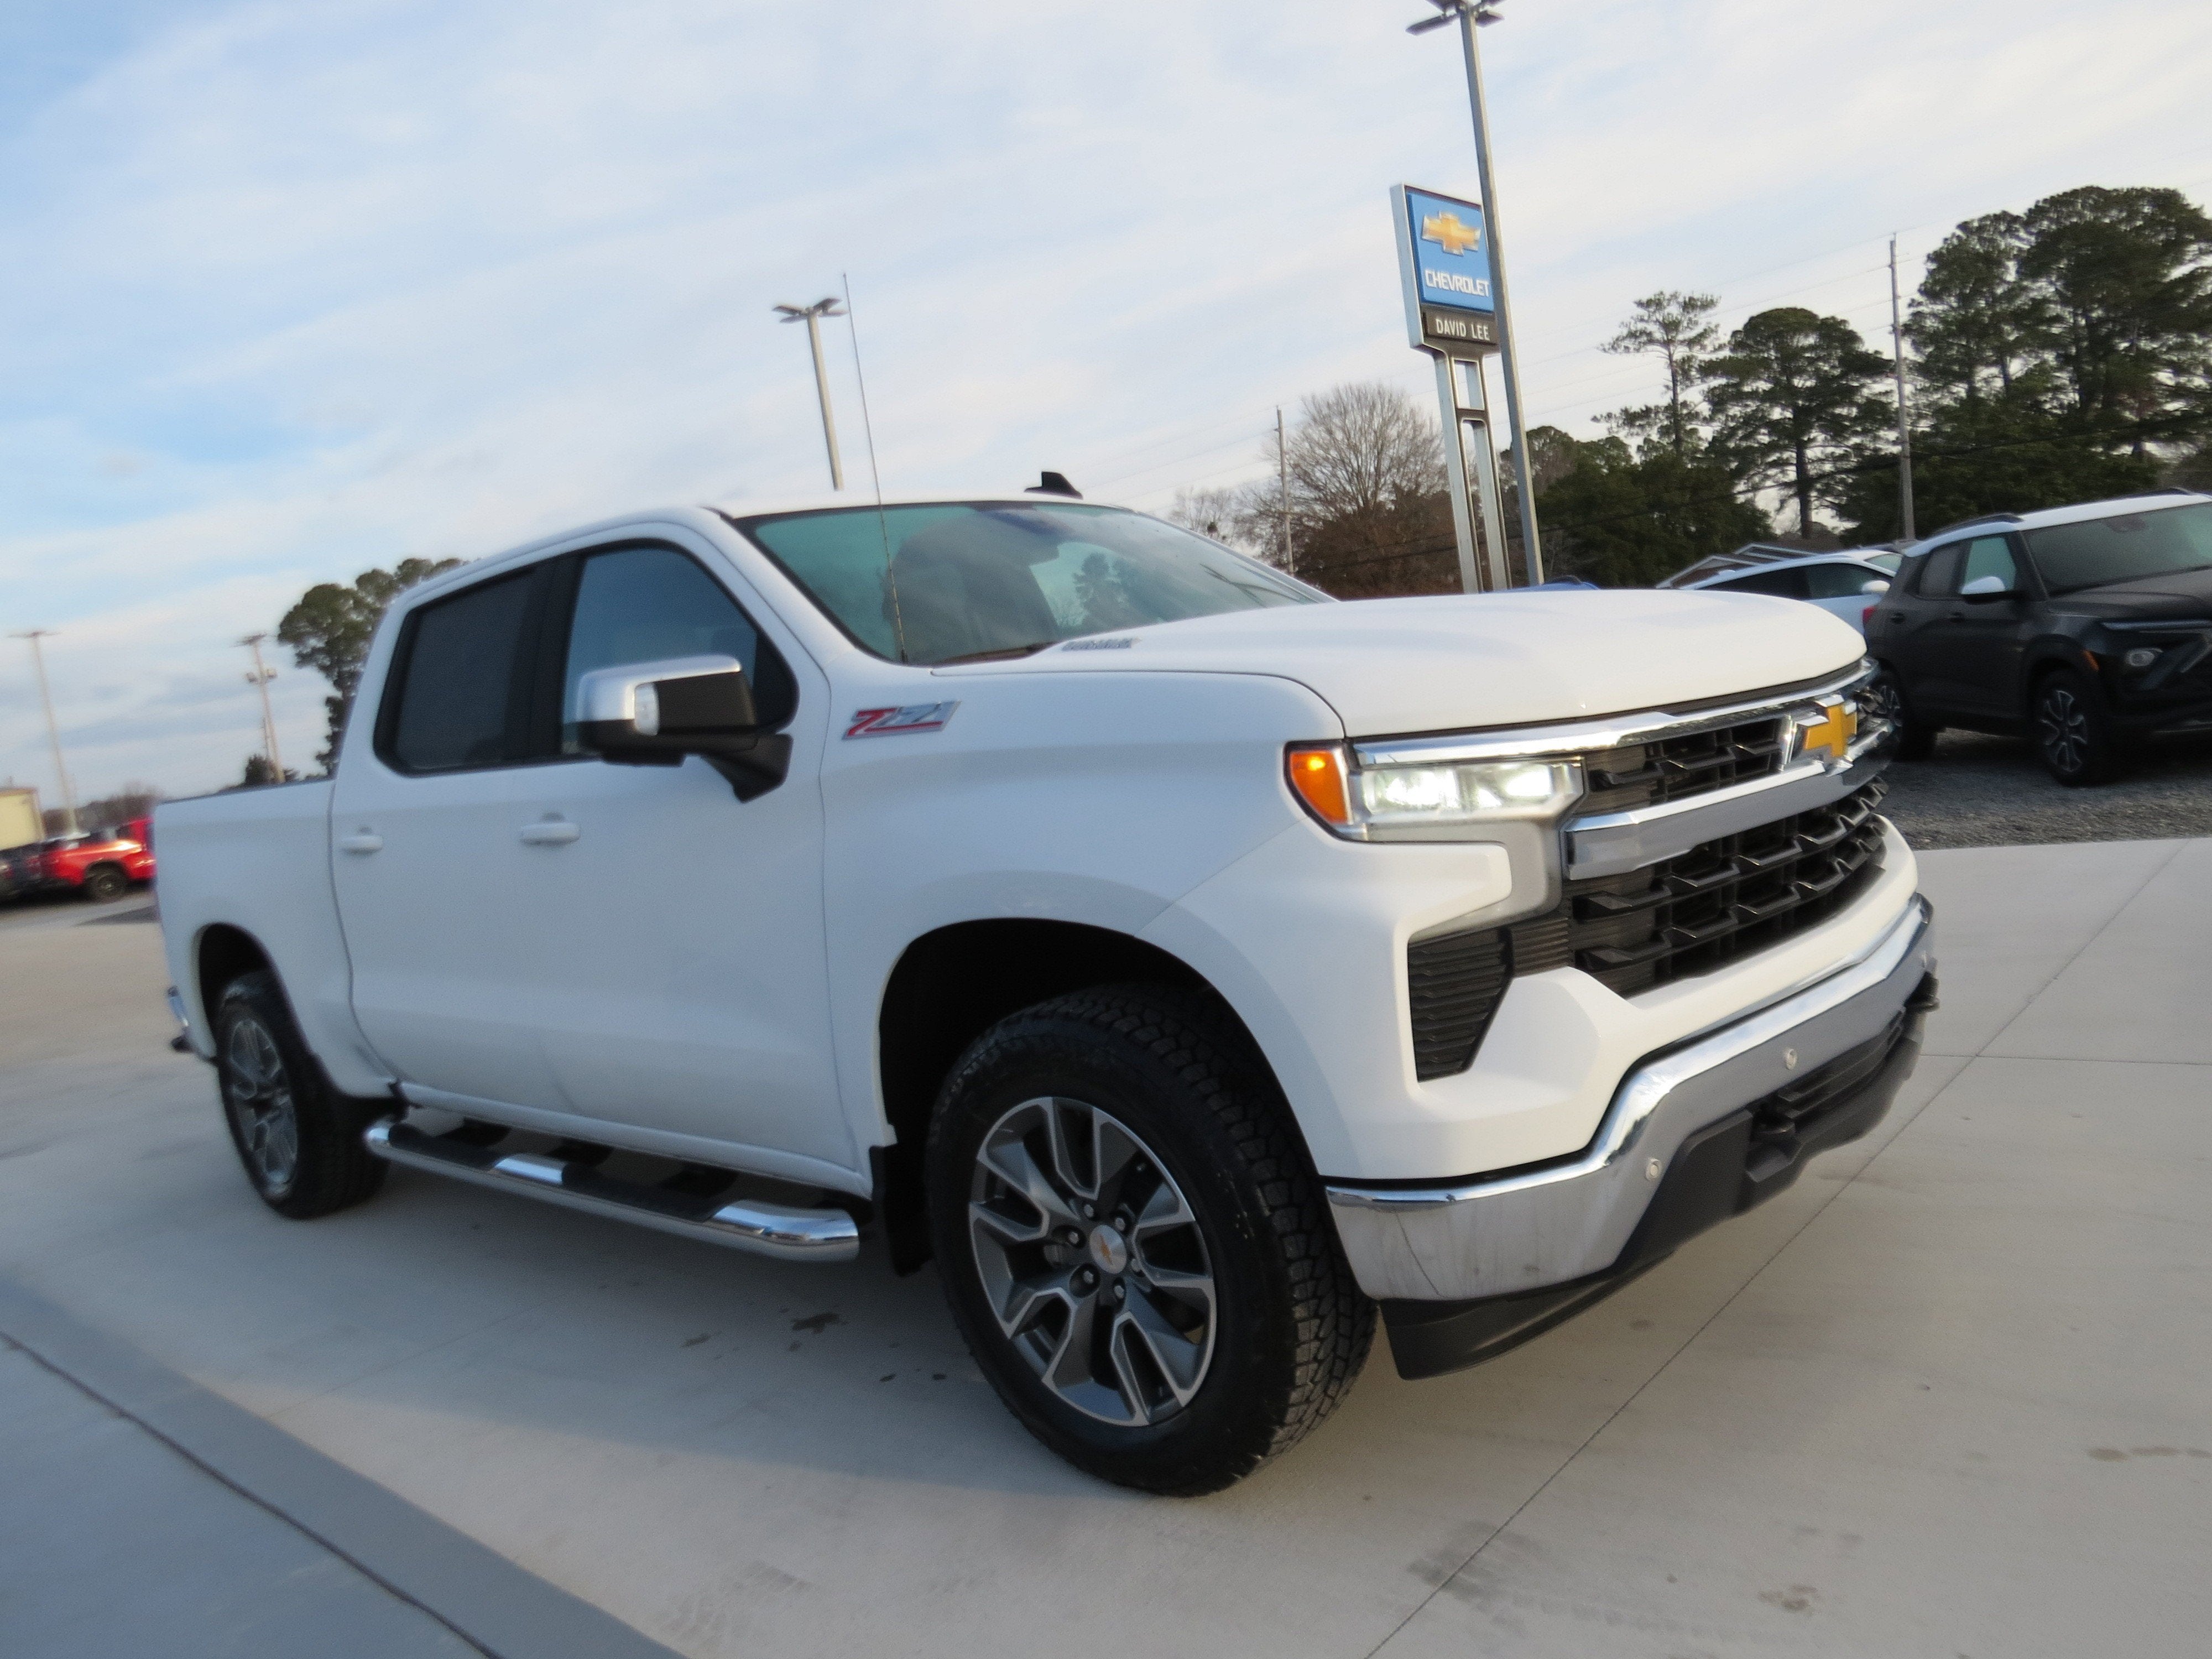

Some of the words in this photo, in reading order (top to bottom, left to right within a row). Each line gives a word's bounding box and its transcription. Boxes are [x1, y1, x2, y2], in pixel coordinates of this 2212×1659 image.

[1425, 270, 1489, 297] CHEVROLET
[1436, 319, 1467, 337] DAVID
[1471, 324, 1490, 341] LEE
